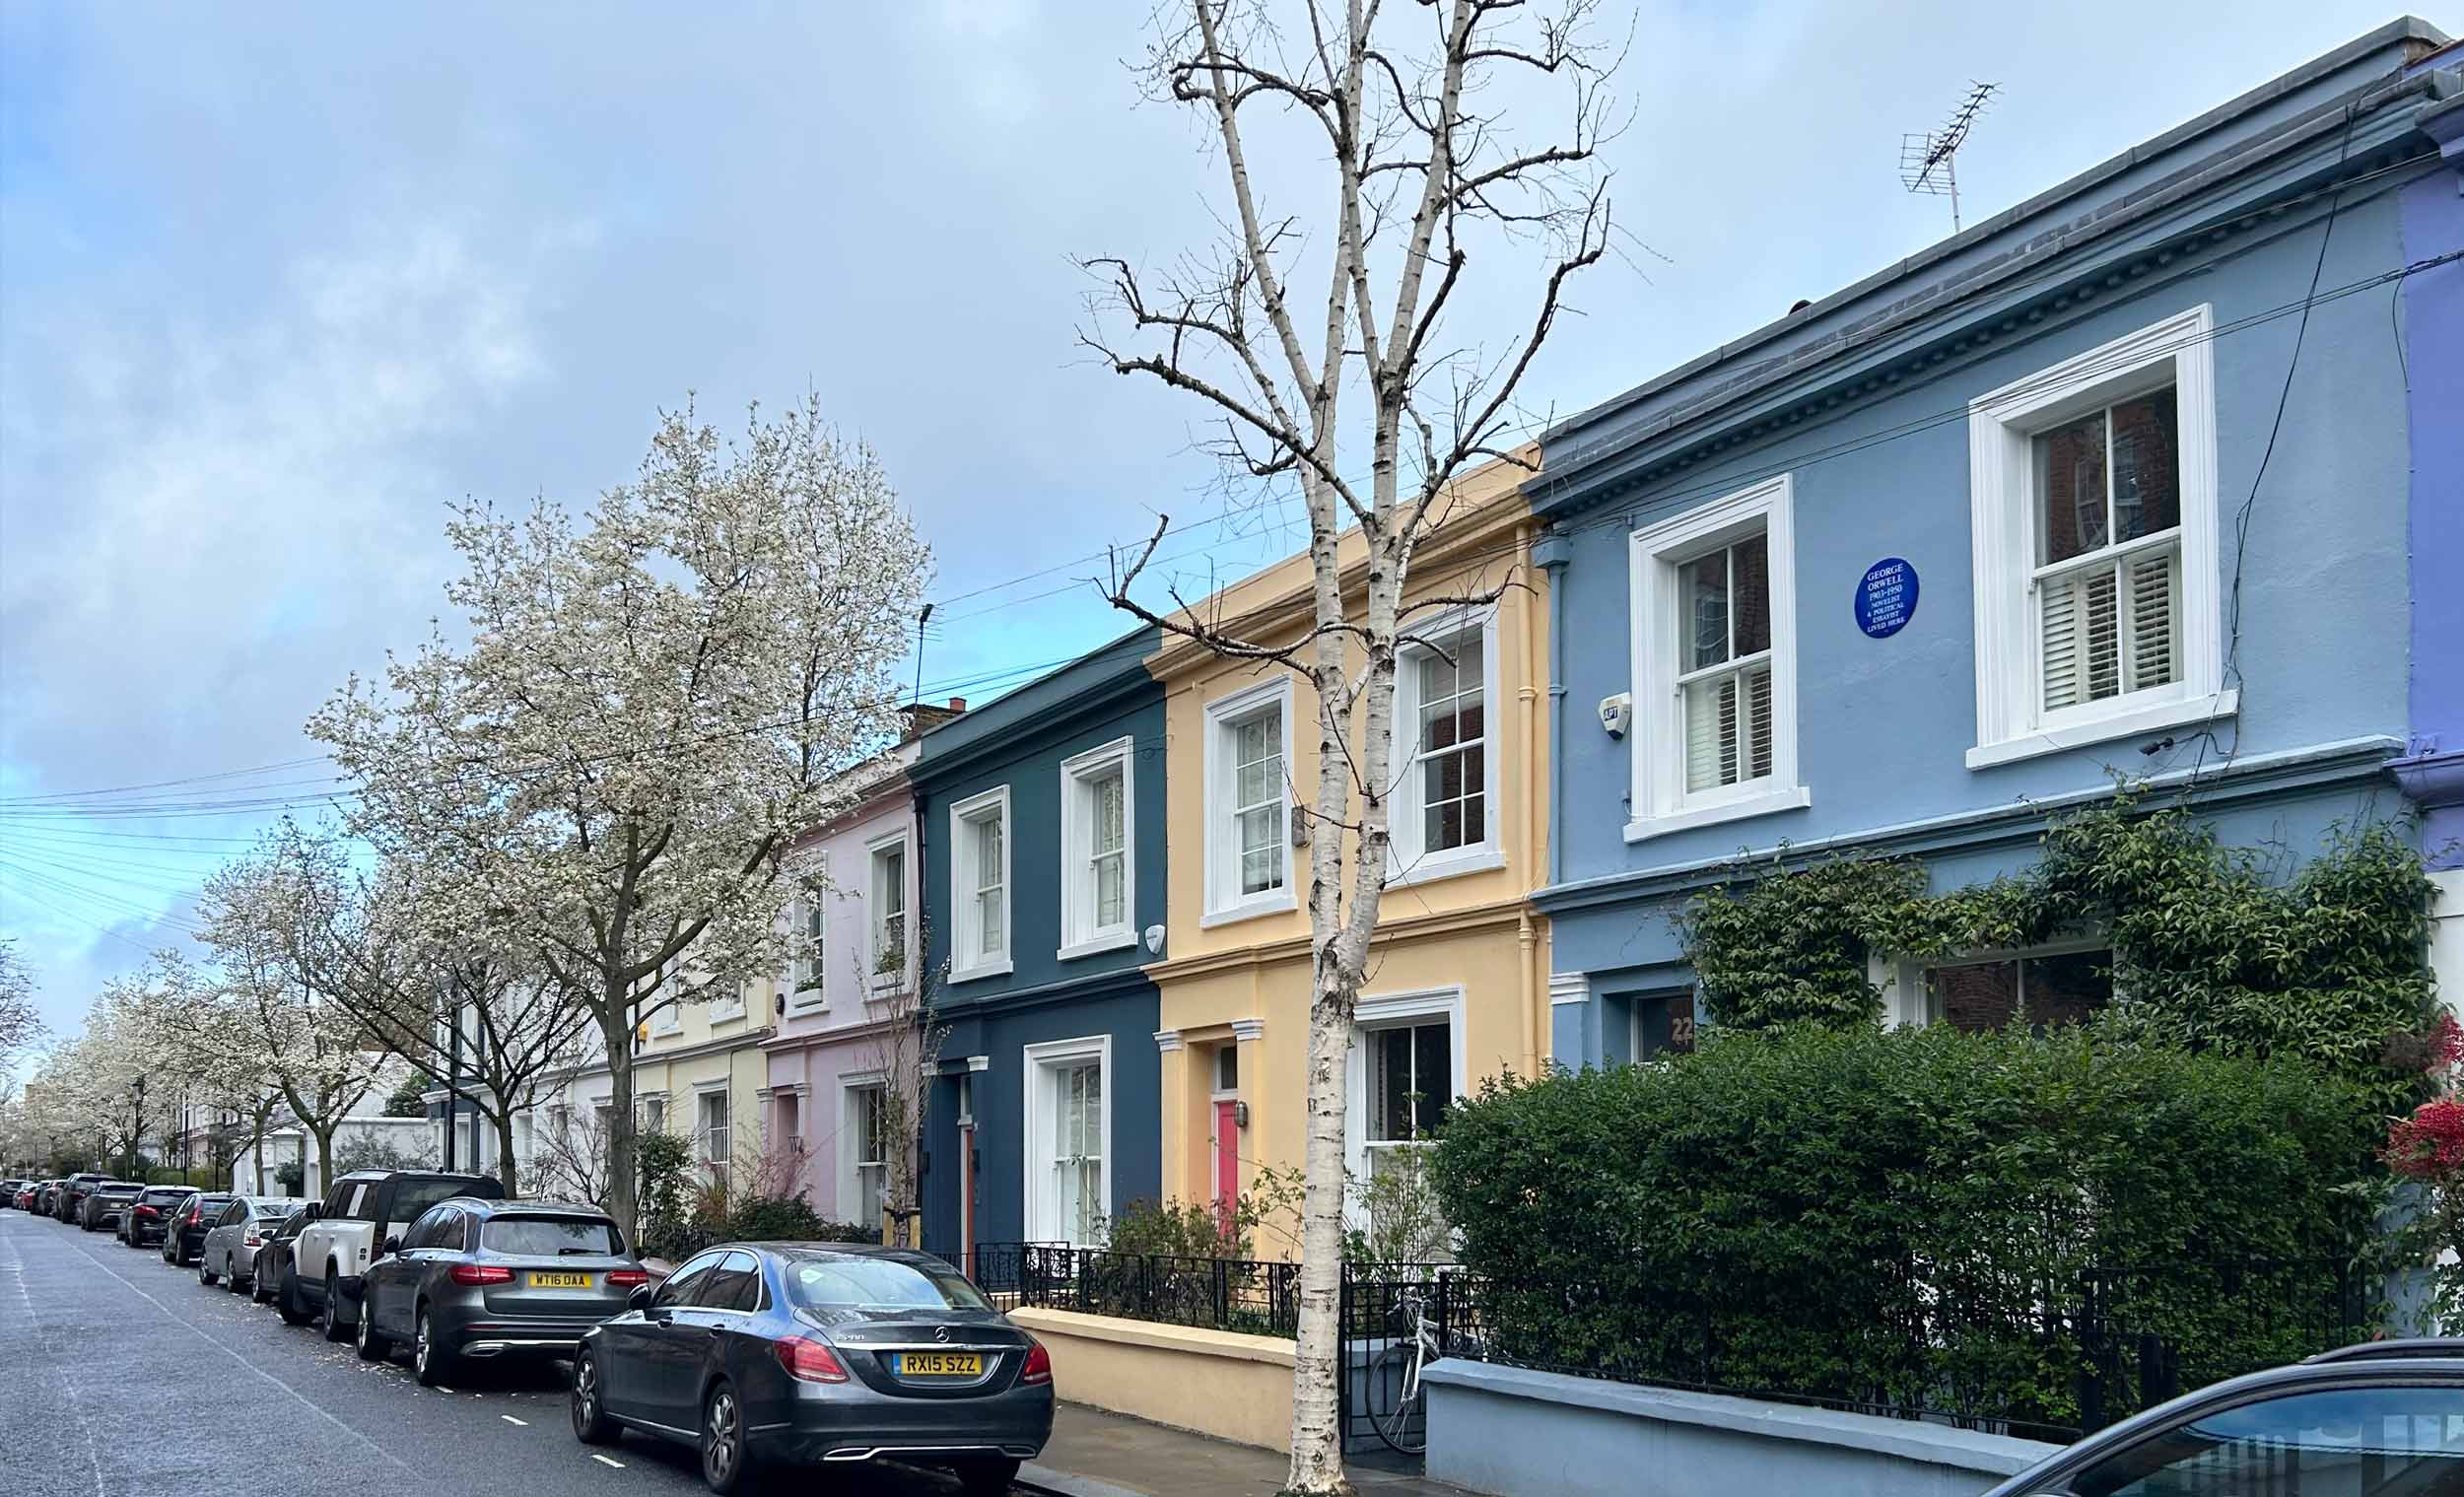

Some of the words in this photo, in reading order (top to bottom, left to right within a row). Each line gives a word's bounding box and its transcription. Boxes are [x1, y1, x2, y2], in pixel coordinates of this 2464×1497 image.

[1868, 563, 1903, 581] GEORGE
[1868, 575, 1903, 591] ORWELL
[1871, 594, 1900, 608] NOVELIST
[1873, 601, 1904, 616] POLITICAL
[1867, 622, 1886, 633] LIVED
[1887, 616, 1905, 626] HERE
[1872, 610, 1900, 624] ESSAYIST
[536, 1274, 561, 1285] WT16
[907, 1356, 941, 1372] RX15
[946, 1356, 976, 1372] SZZ
